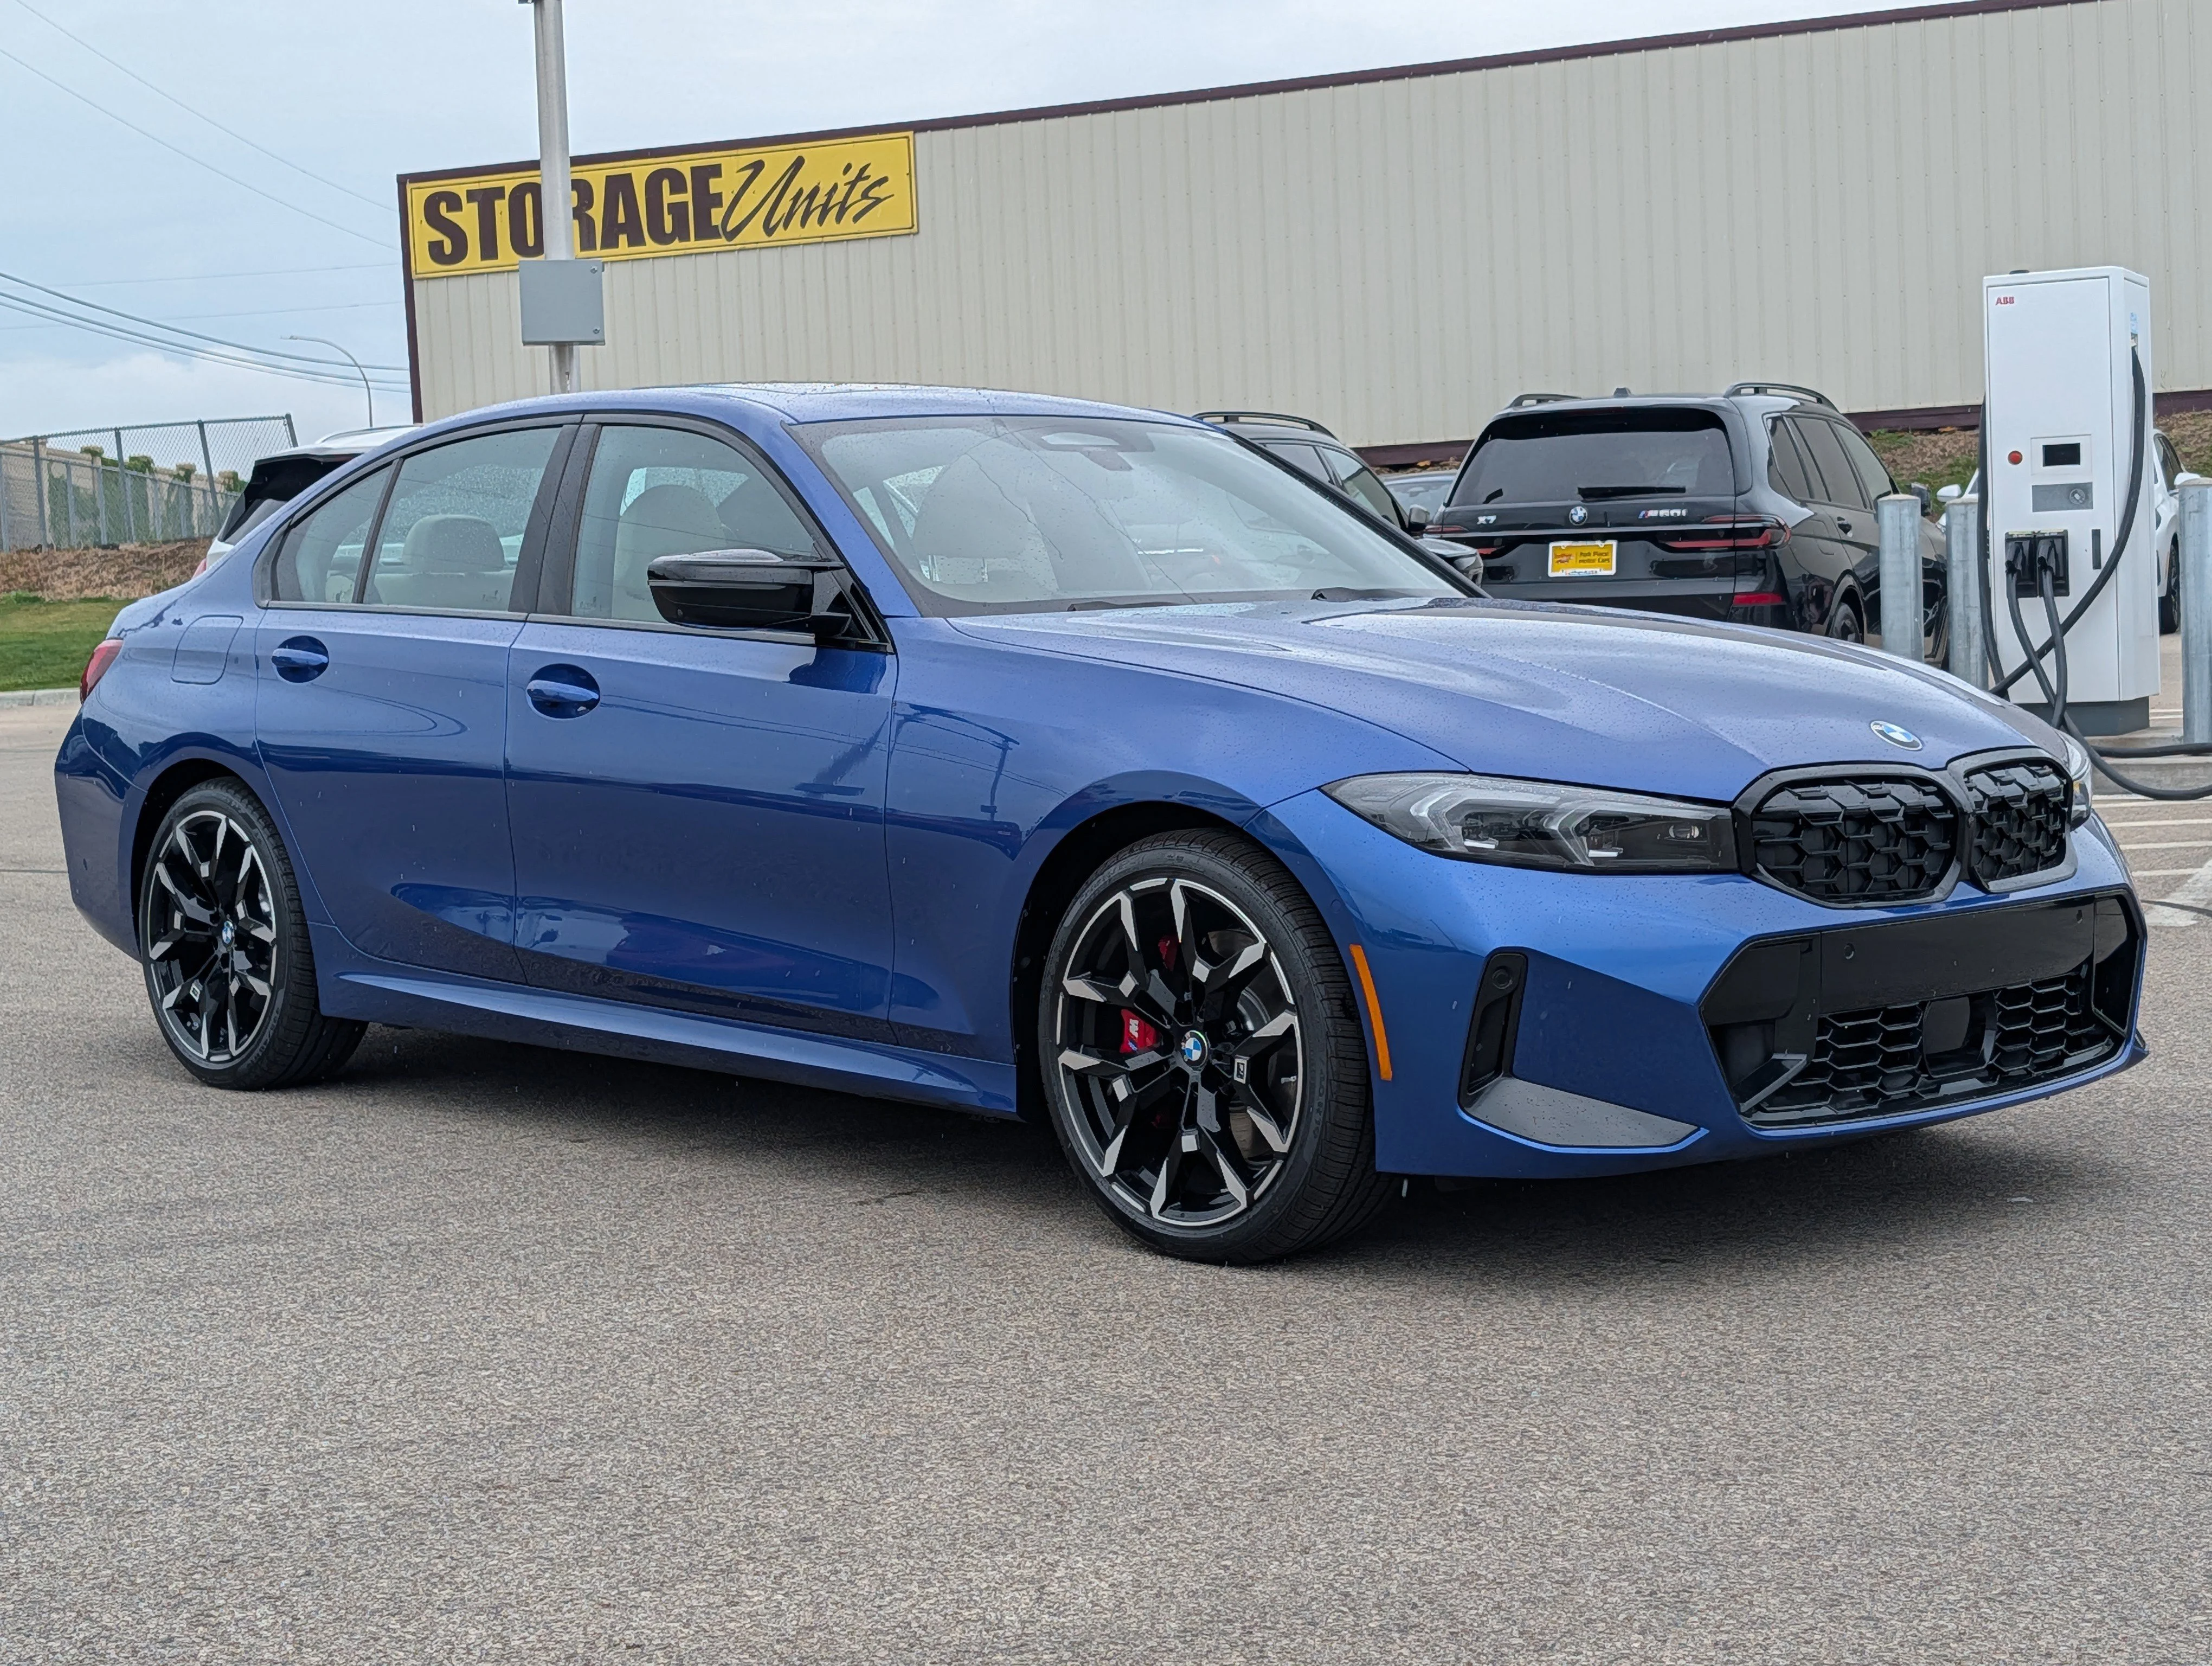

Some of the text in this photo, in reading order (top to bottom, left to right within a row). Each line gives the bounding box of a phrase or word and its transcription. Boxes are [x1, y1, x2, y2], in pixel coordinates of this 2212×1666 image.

[423, 156, 895, 265] STORAGE Units
[1995, 296, 2014, 305] ABB
[1477, 515, 1496, 524] X7
